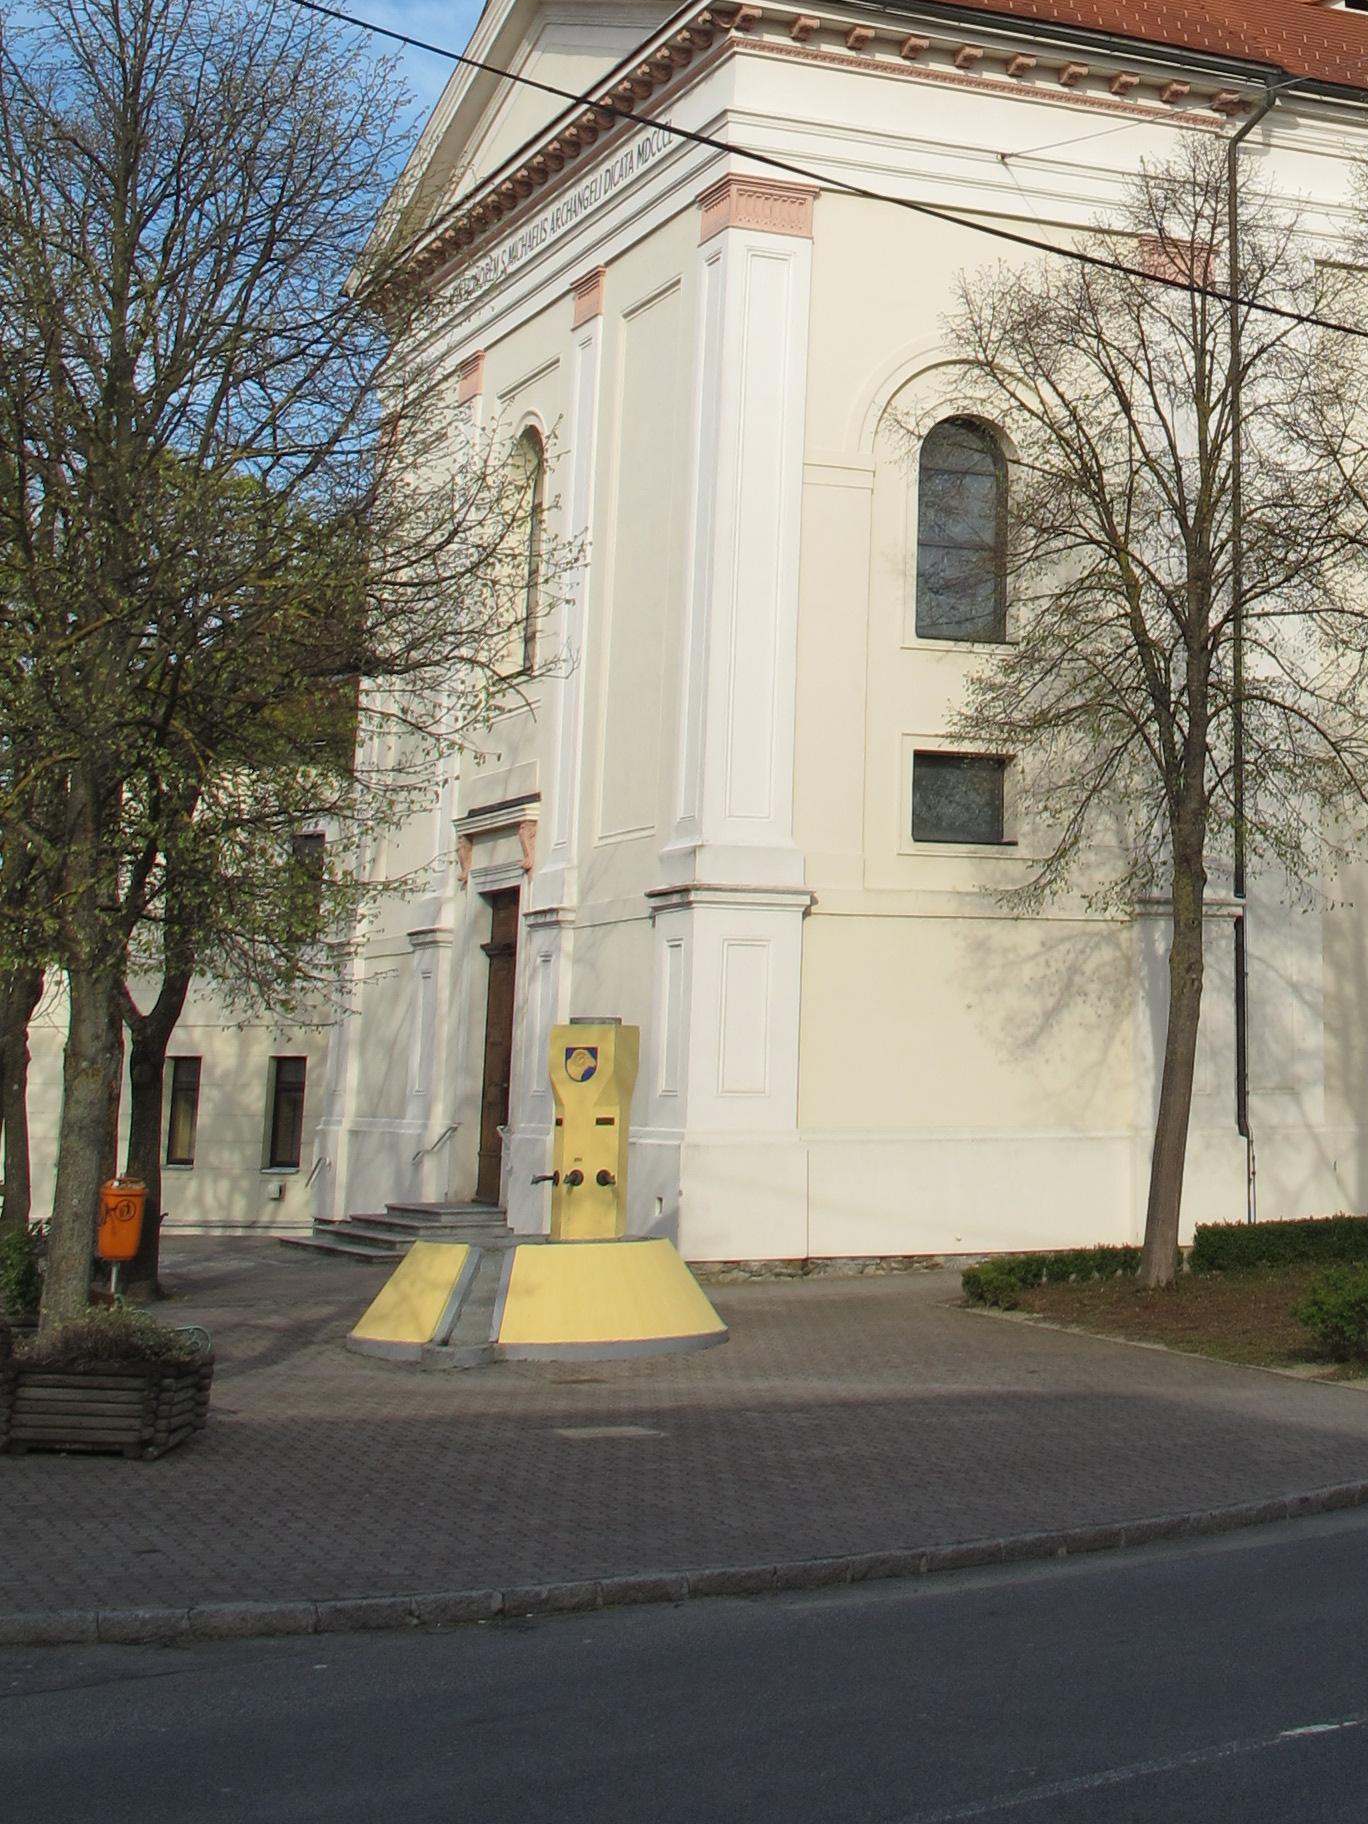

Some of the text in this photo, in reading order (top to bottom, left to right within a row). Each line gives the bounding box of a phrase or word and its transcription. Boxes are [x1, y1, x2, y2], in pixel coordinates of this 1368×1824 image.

[508, 219, 549, 264] MICHAELIS
[549, 179, 602, 237] ARCHANGELI
[603, 151, 634, 195] DICATA
